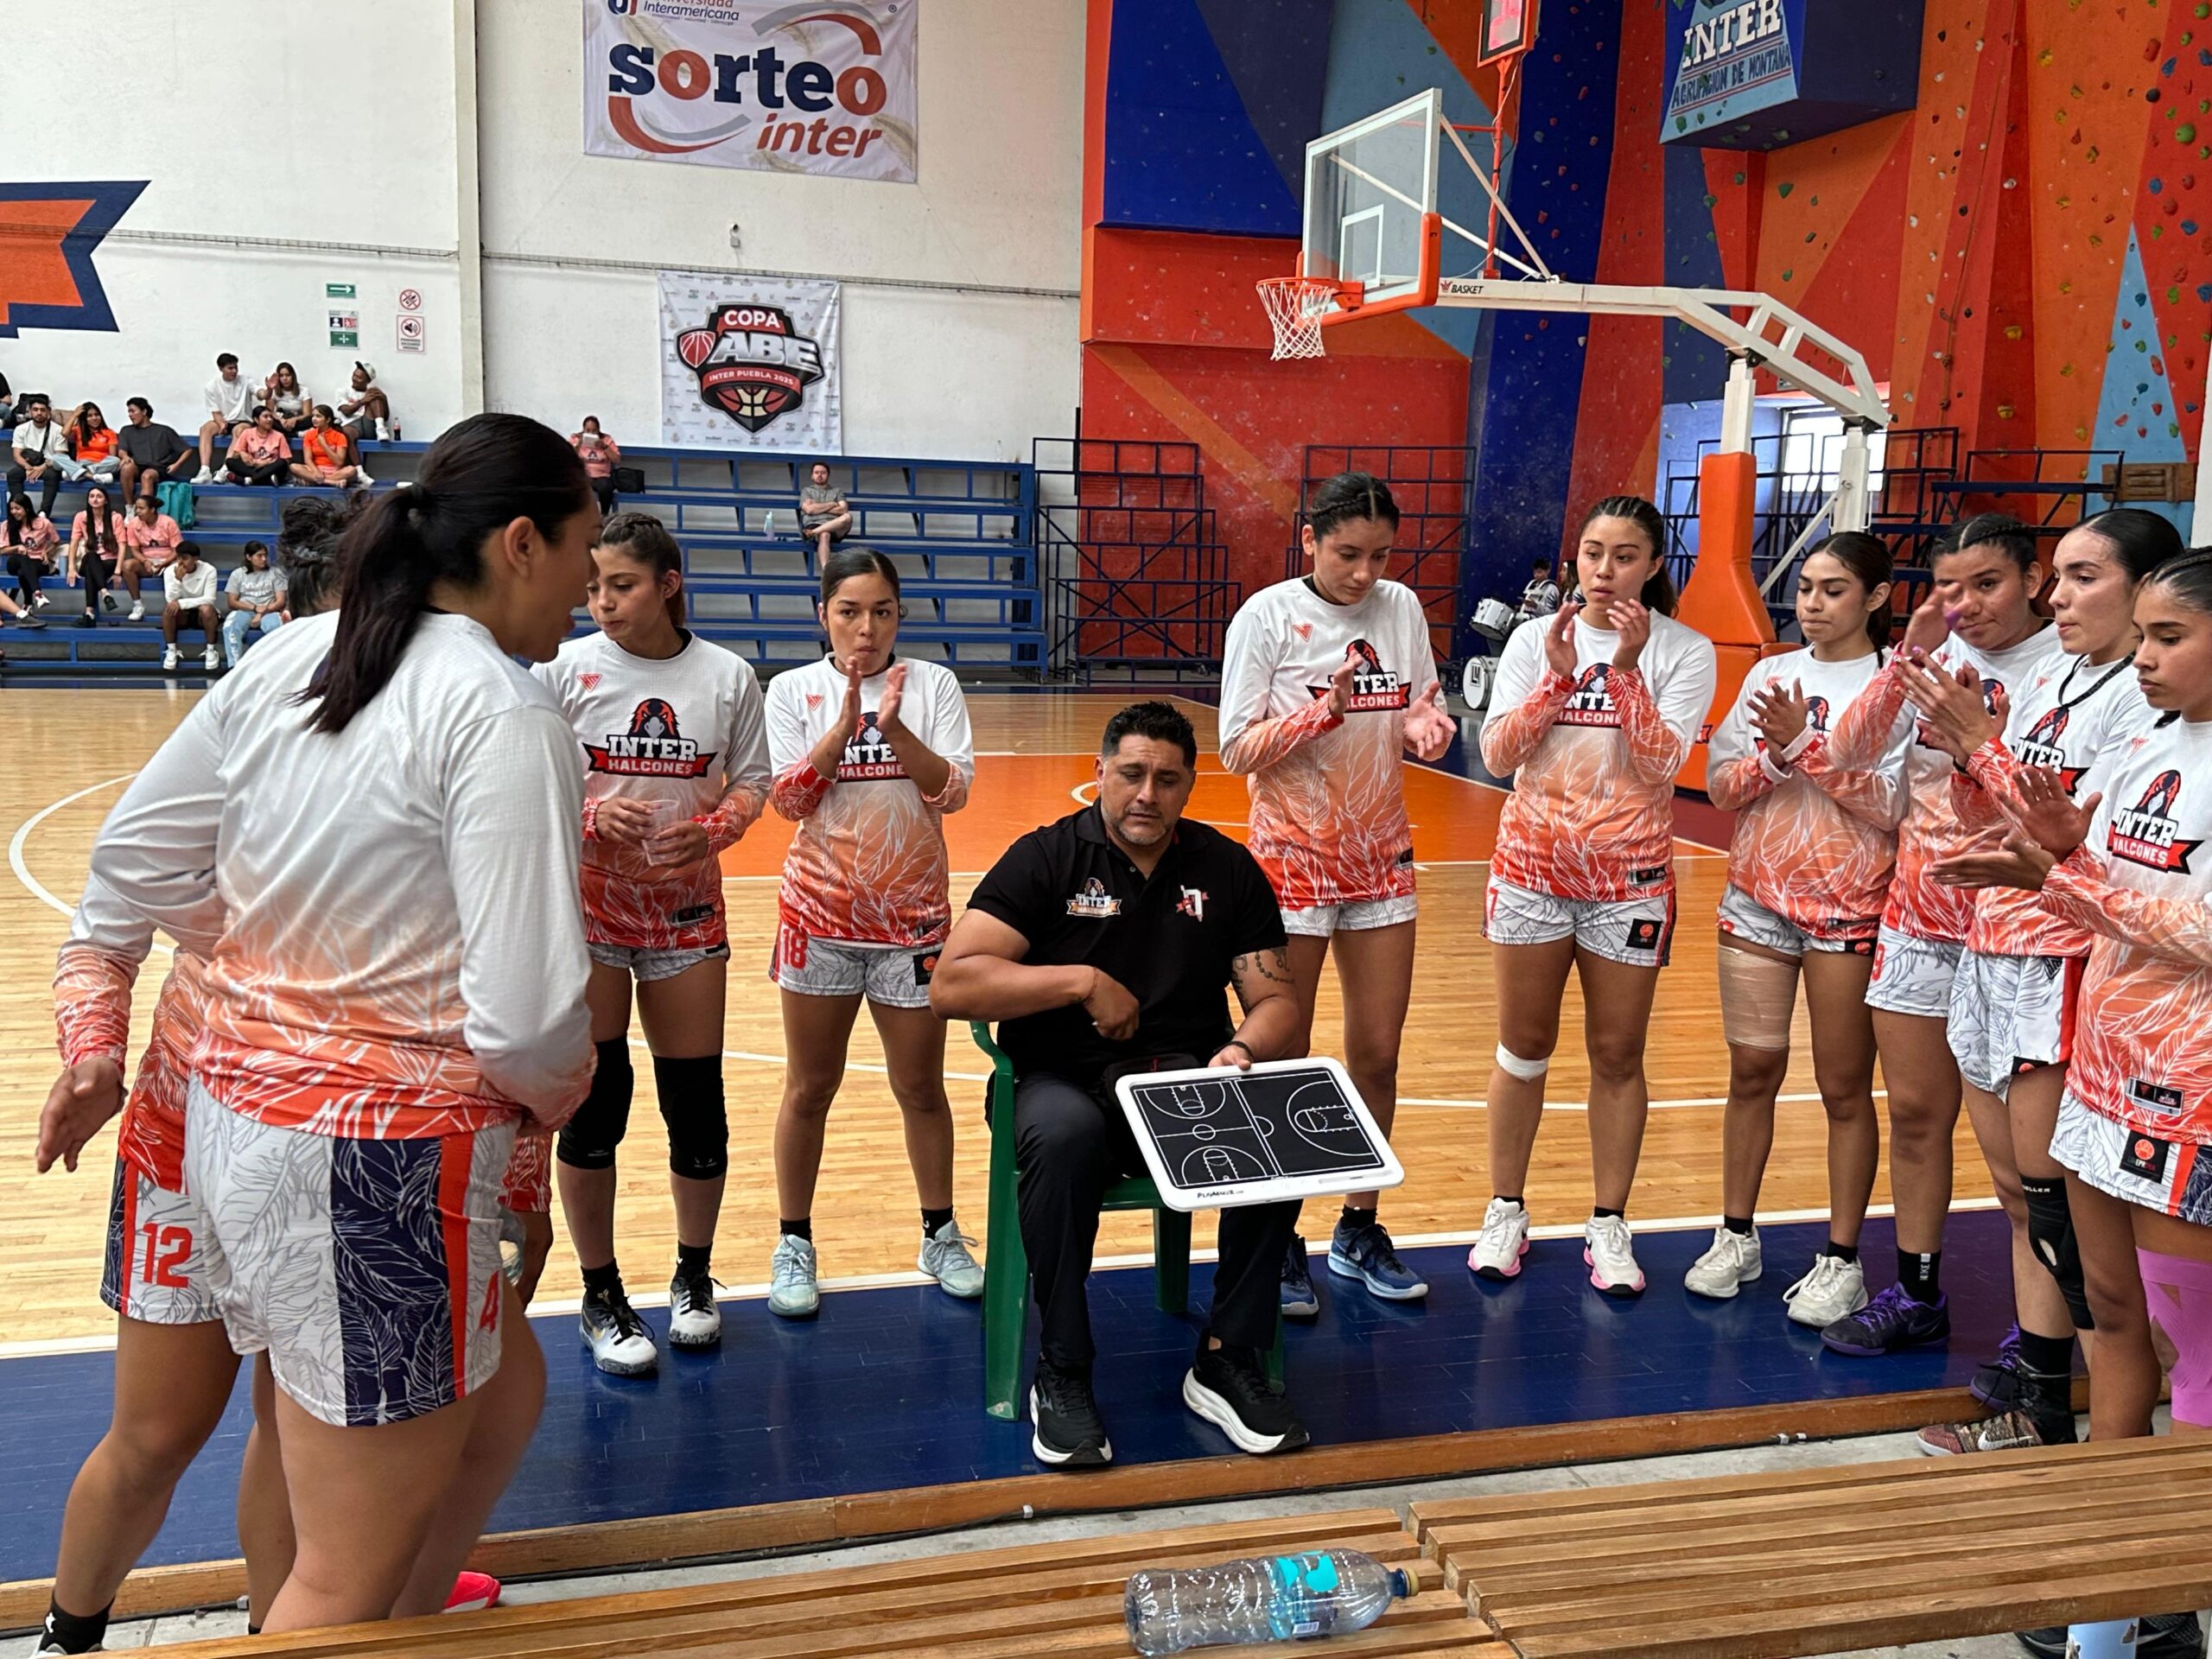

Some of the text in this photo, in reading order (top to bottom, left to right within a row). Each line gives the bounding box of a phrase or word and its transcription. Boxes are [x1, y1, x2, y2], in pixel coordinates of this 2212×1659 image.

[643, 1, 740, 21] Interamericana
[1681, 0, 1782, 69] INTER
[608, 43, 887, 116] sorteo
[1732, 61, 1745, 86] DE
[757, 112, 882, 158] inter
[1451, 284, 1484, 295] BASKET
[724, 309, 780, 328] COPA
[707, 331, 822, 373] ABE
[709, 370, 794, 385] INTER PUEBLA 2025
[1351, 672, 1400, 695] TER
[1350, 695, 1400, 708] LCONES
[1565, 691, 1617, 710] NTE
[1558, 710, 1622, 724] ALCONE
[607, 735, 697, 761] INTER
[838, 743, 897, 766] NTE
[607, 760, 694, 774] HALCONES
[836, 765, 906, 777] HALCONE
[2114, 810, 2178, 849] INTER
[2113, 837, 2168, 865] HALCONES
[783, 928, 809, 969] 18
[143, 1223, 193, 1288] 12
[479, 1270, 499, 1334] 4
